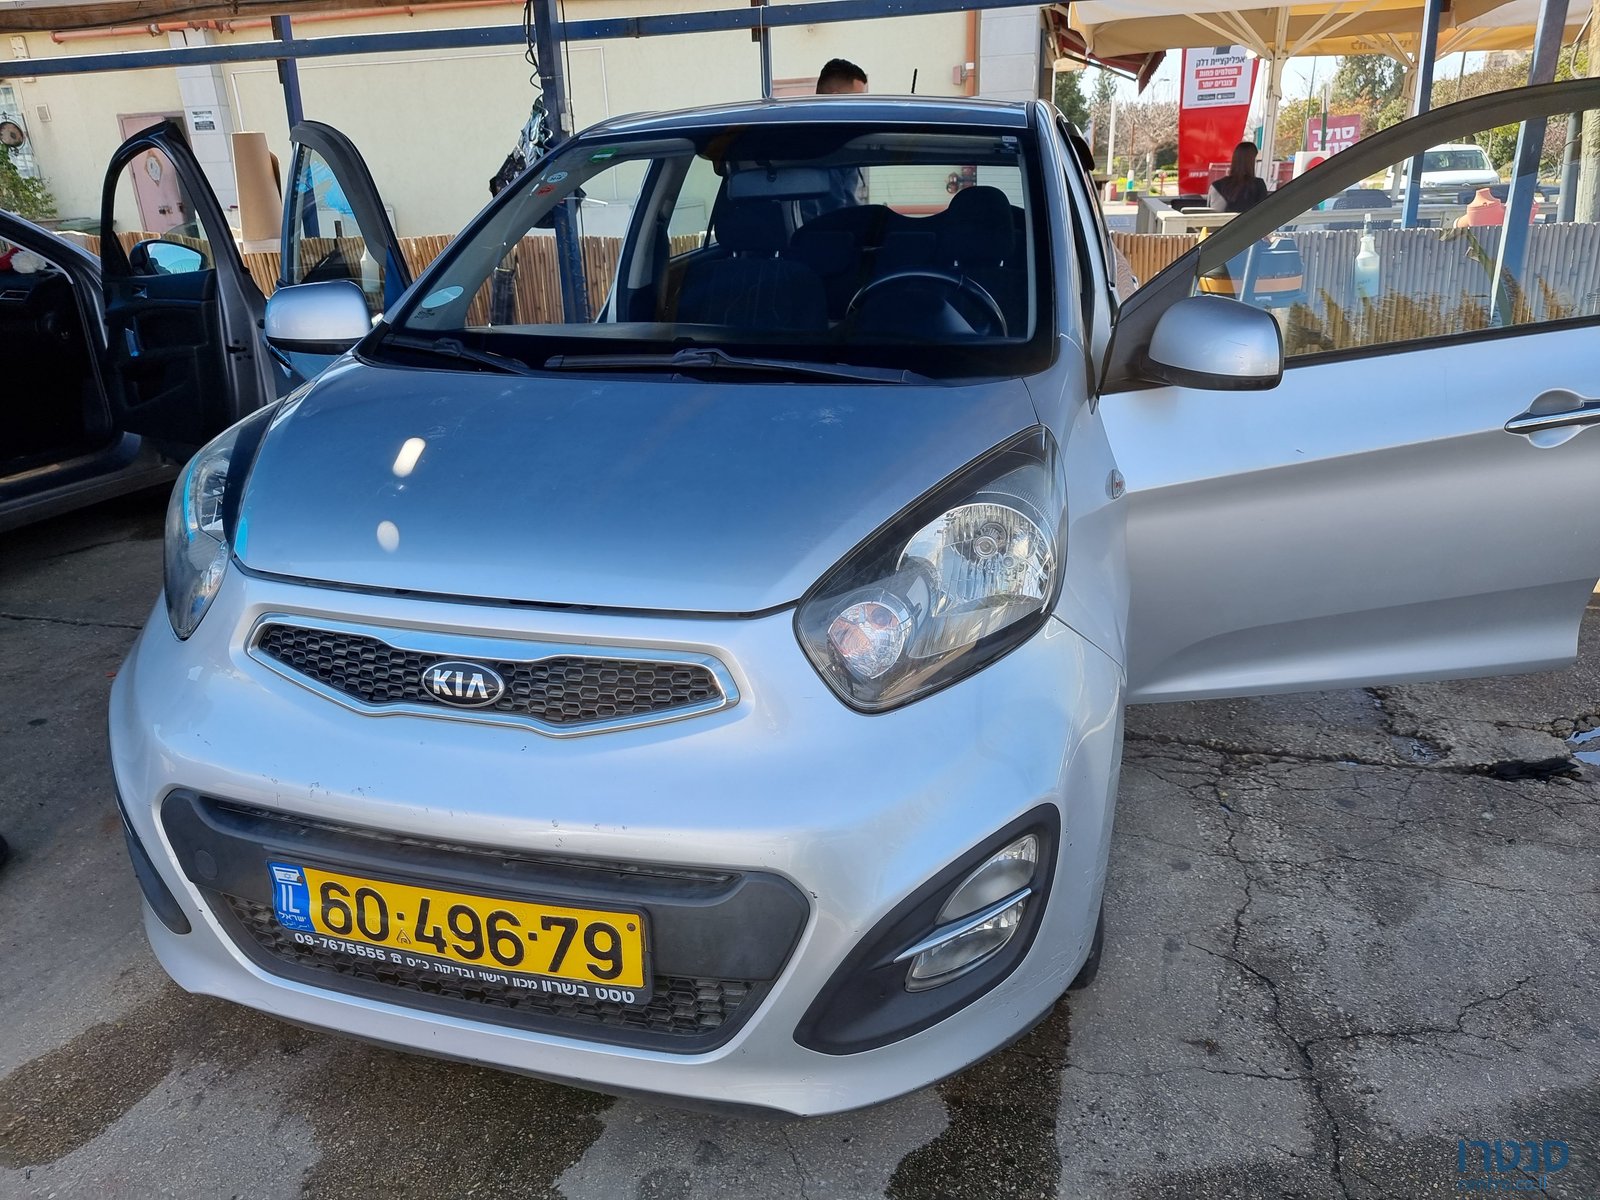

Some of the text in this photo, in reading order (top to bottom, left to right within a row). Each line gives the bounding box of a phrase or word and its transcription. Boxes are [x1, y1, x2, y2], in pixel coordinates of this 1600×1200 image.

[1196, 58, 1209, 68] דלק
[1312, 126, 1355, 142] סולר
[433, 669, 489, 699] KIA
[281, 884, 300, 914] IL
[278, 911, 306, 922] ישראל
[294, 932, 386, 961] 09-7675555
[433, 962, 476, 979] ובדיקה
[479, 971, 509, 985] רישוי
[512, 976, 538, 990] מכון
[541, 980, 590, 998] בשרון
[594, 987, 635, 1004] טסט
